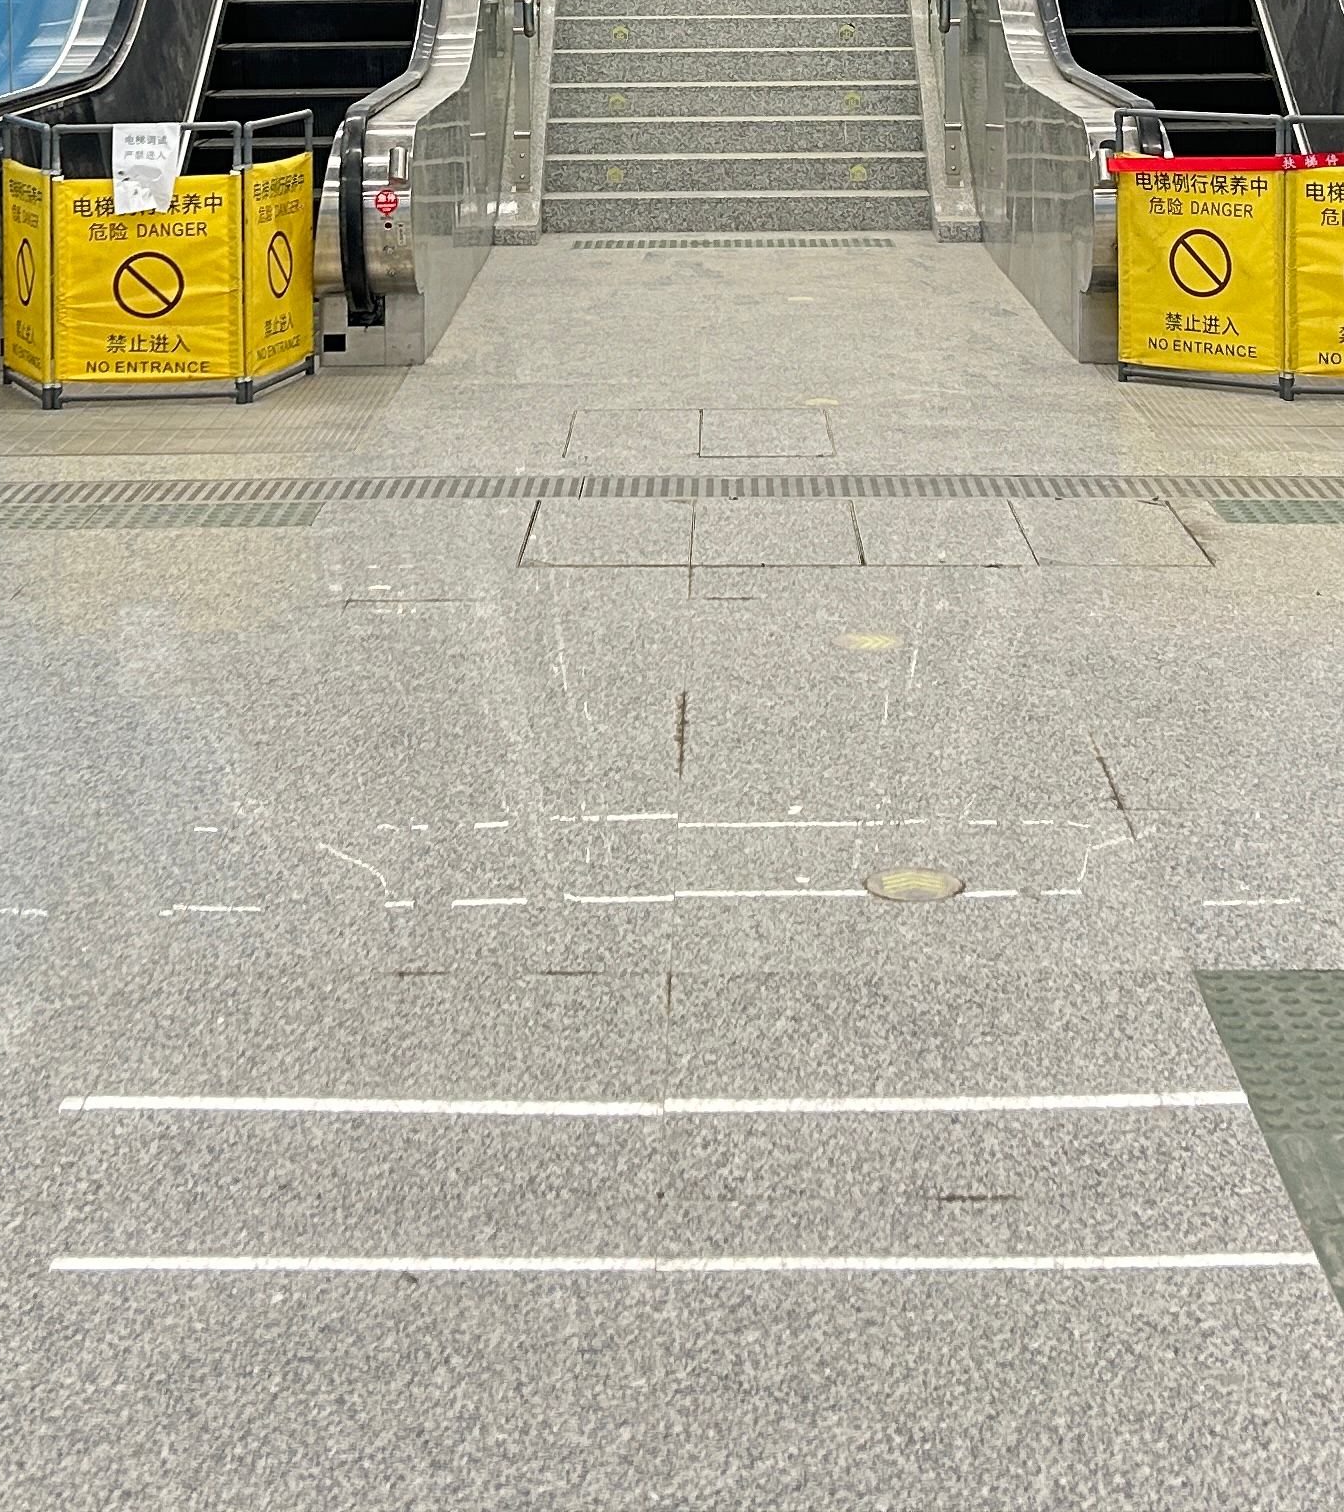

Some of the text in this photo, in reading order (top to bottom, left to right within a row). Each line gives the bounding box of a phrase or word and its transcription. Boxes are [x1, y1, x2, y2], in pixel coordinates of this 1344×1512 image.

[1135, 172, 1268, 198] 电梯例行保养中
[73, 192, 223, 218] 电梯保养中
[1149, 196, 1254, 219] 危险 DANGER
[88, 221, 208, 242] 危险 DANGER
[1165, 312, 1240, 337] 禁止进入
[106, 333, 191, 354] 禁止进入
[1147, 337, 1258, 359] NO ENTRANCE
[86, 360, 210, 374] NO ENTRANCE
[1318, 352, 1342, 366] NO
